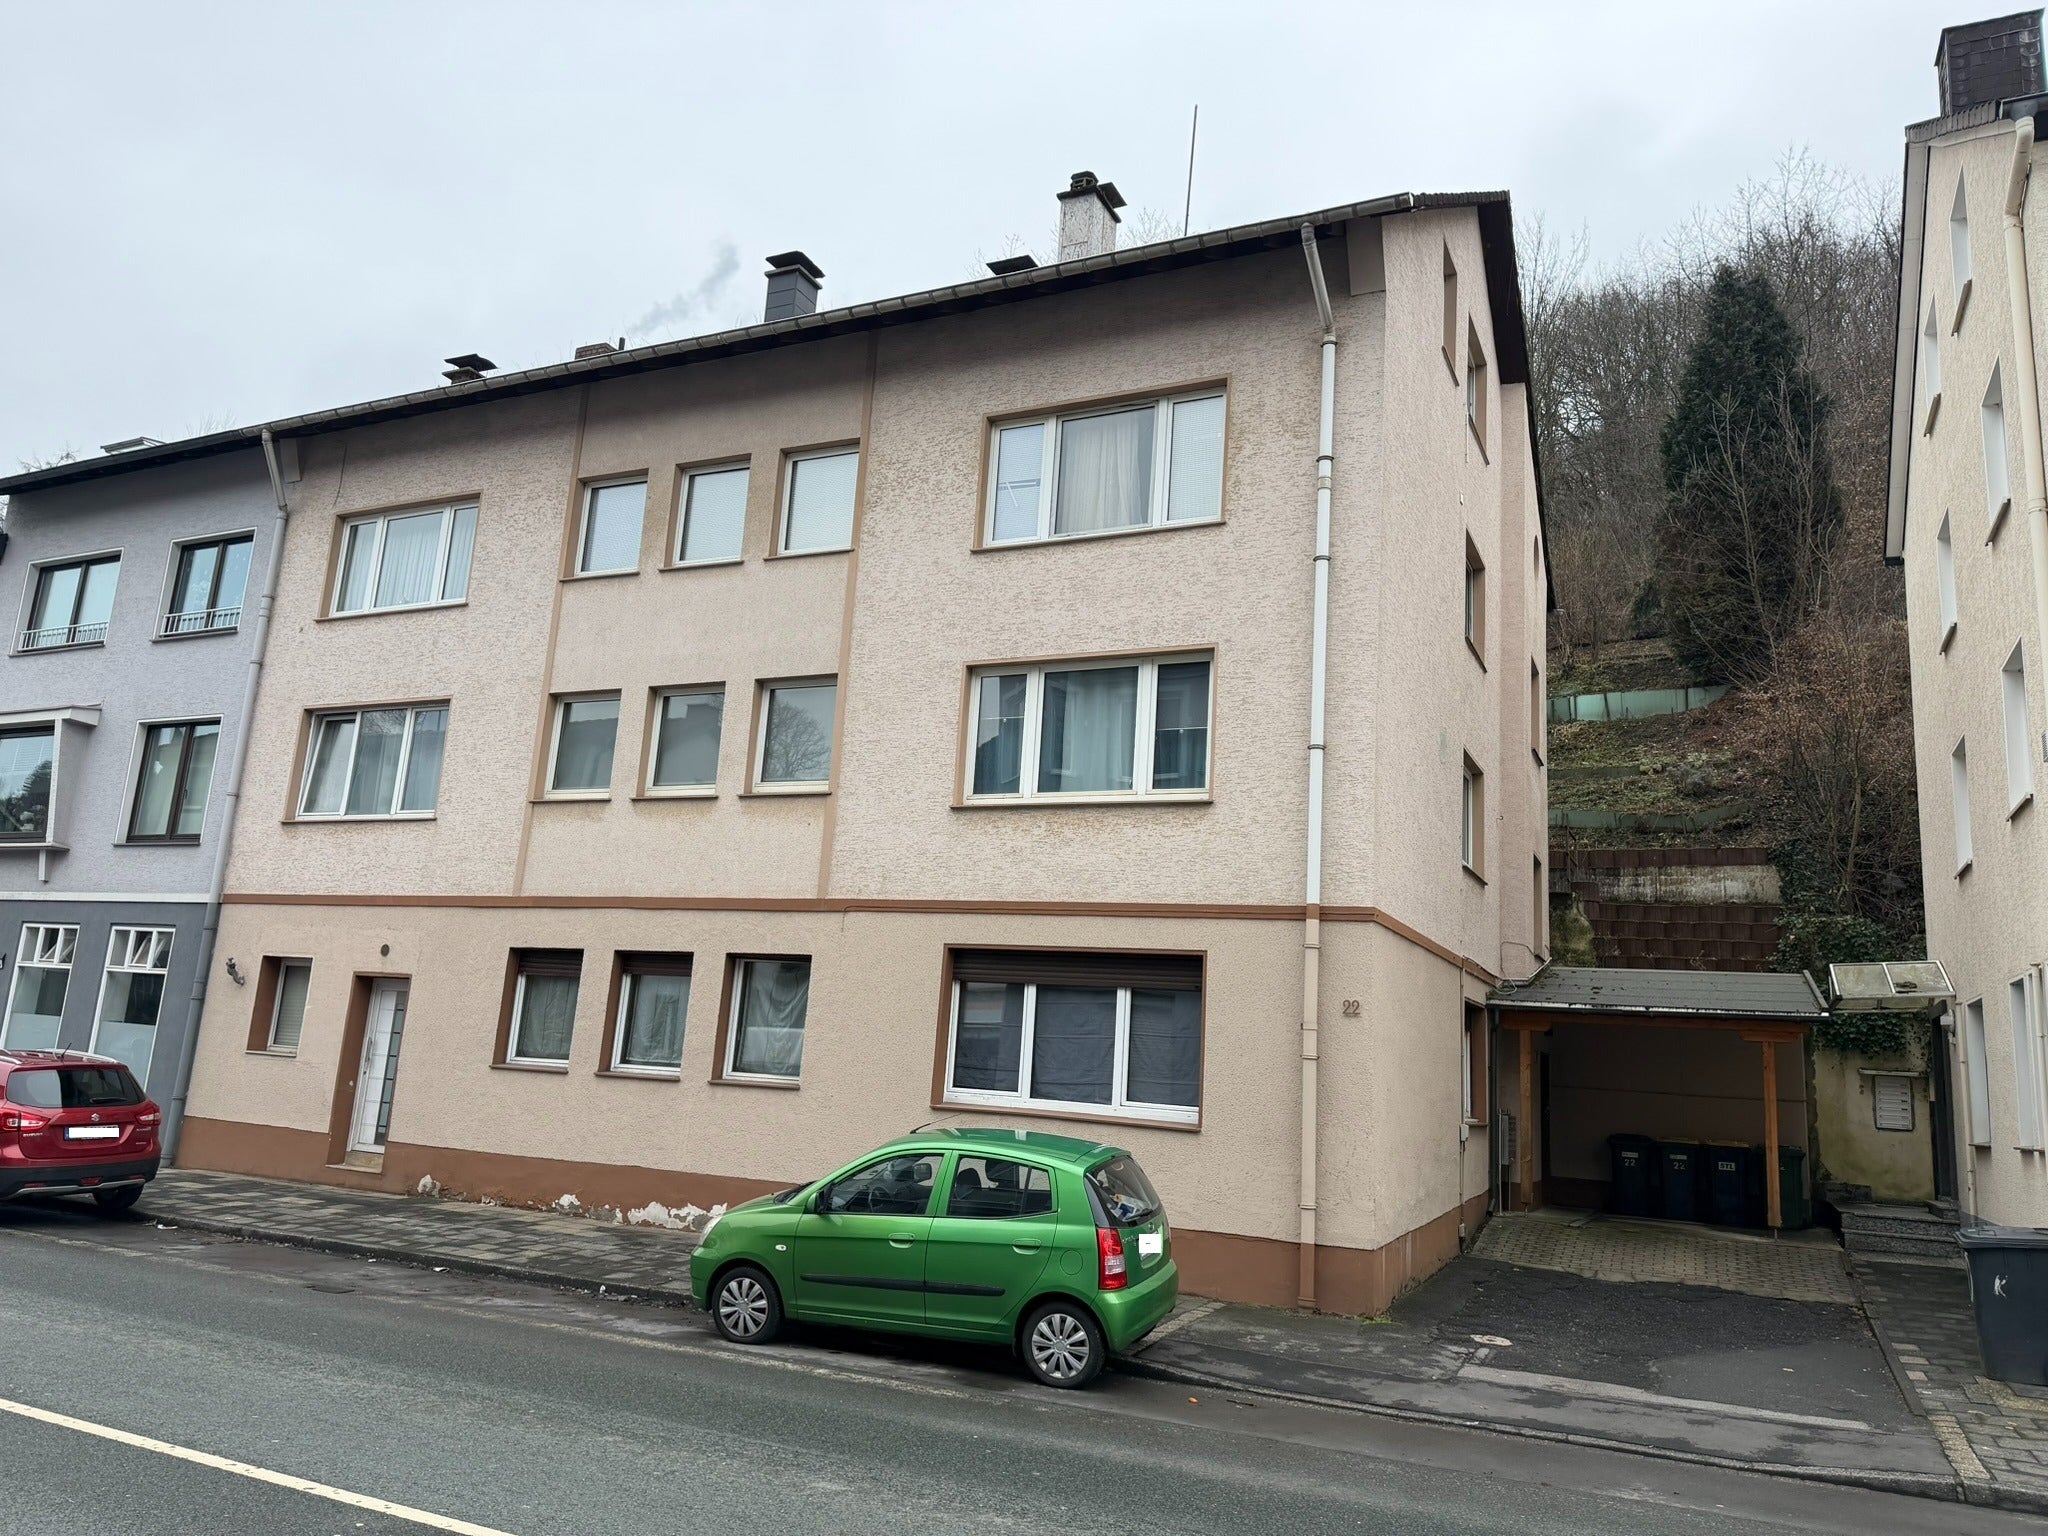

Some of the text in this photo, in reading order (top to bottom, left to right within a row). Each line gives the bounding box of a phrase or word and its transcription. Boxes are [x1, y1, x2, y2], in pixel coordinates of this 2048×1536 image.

[1342, 1000, 1360, 1015] 22
[1624, 1158, 1636, 1167] 22
[1673, 1161, 1686, 1170] 22
